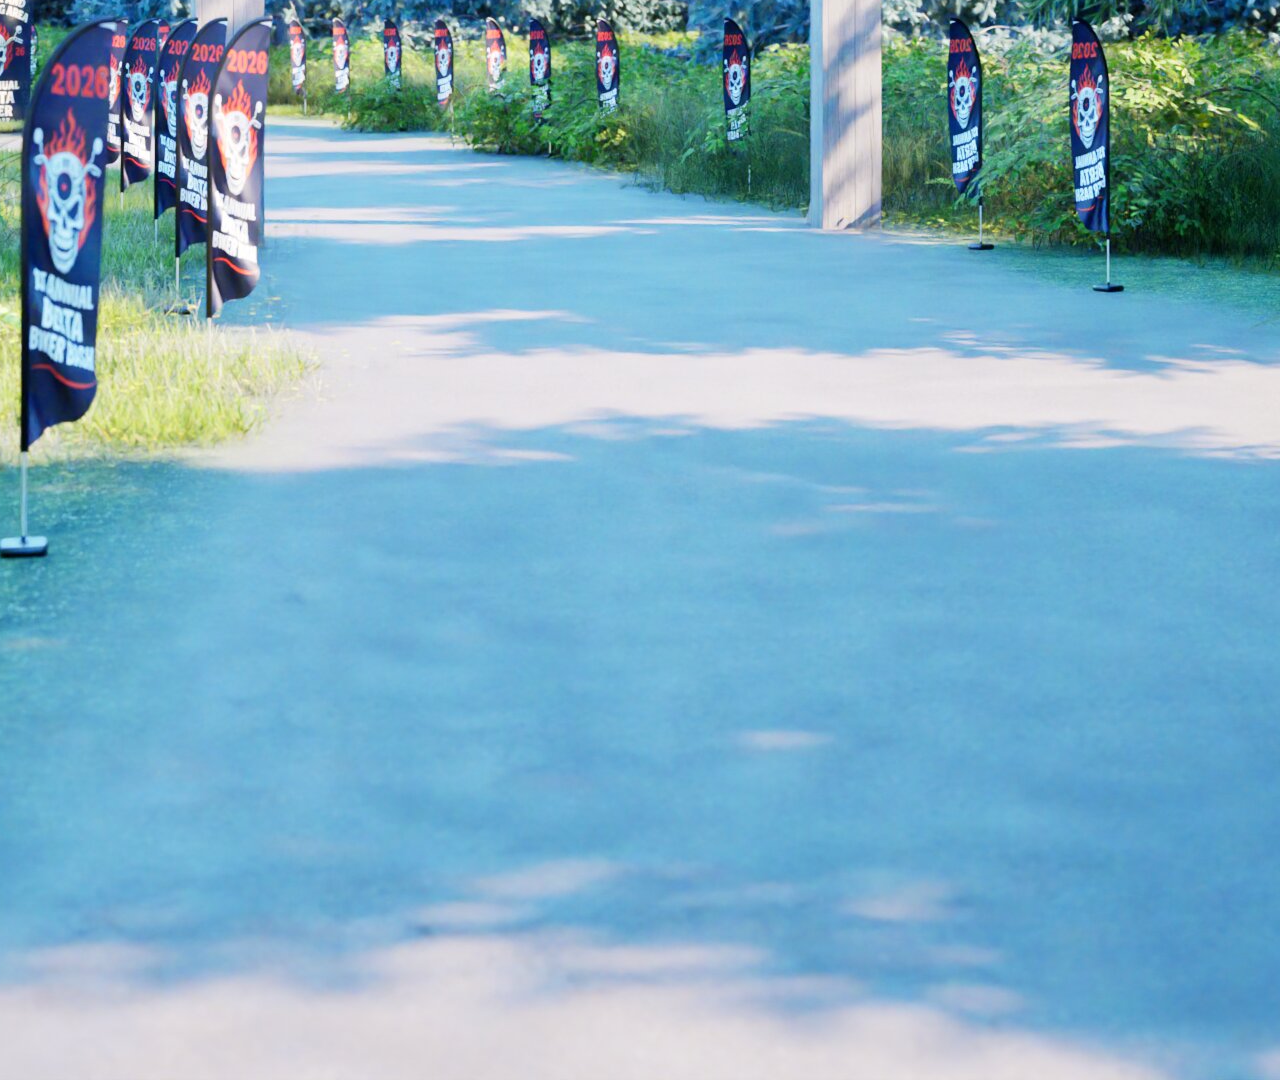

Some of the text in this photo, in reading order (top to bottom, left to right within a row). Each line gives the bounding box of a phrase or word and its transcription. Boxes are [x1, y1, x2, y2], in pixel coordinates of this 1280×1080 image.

[6, 5, 29, 23] AREA
[168, 39, 189, 55] 202
[227, 48, 268, 74] 2026
[51, 63, 109, 99] 2026
